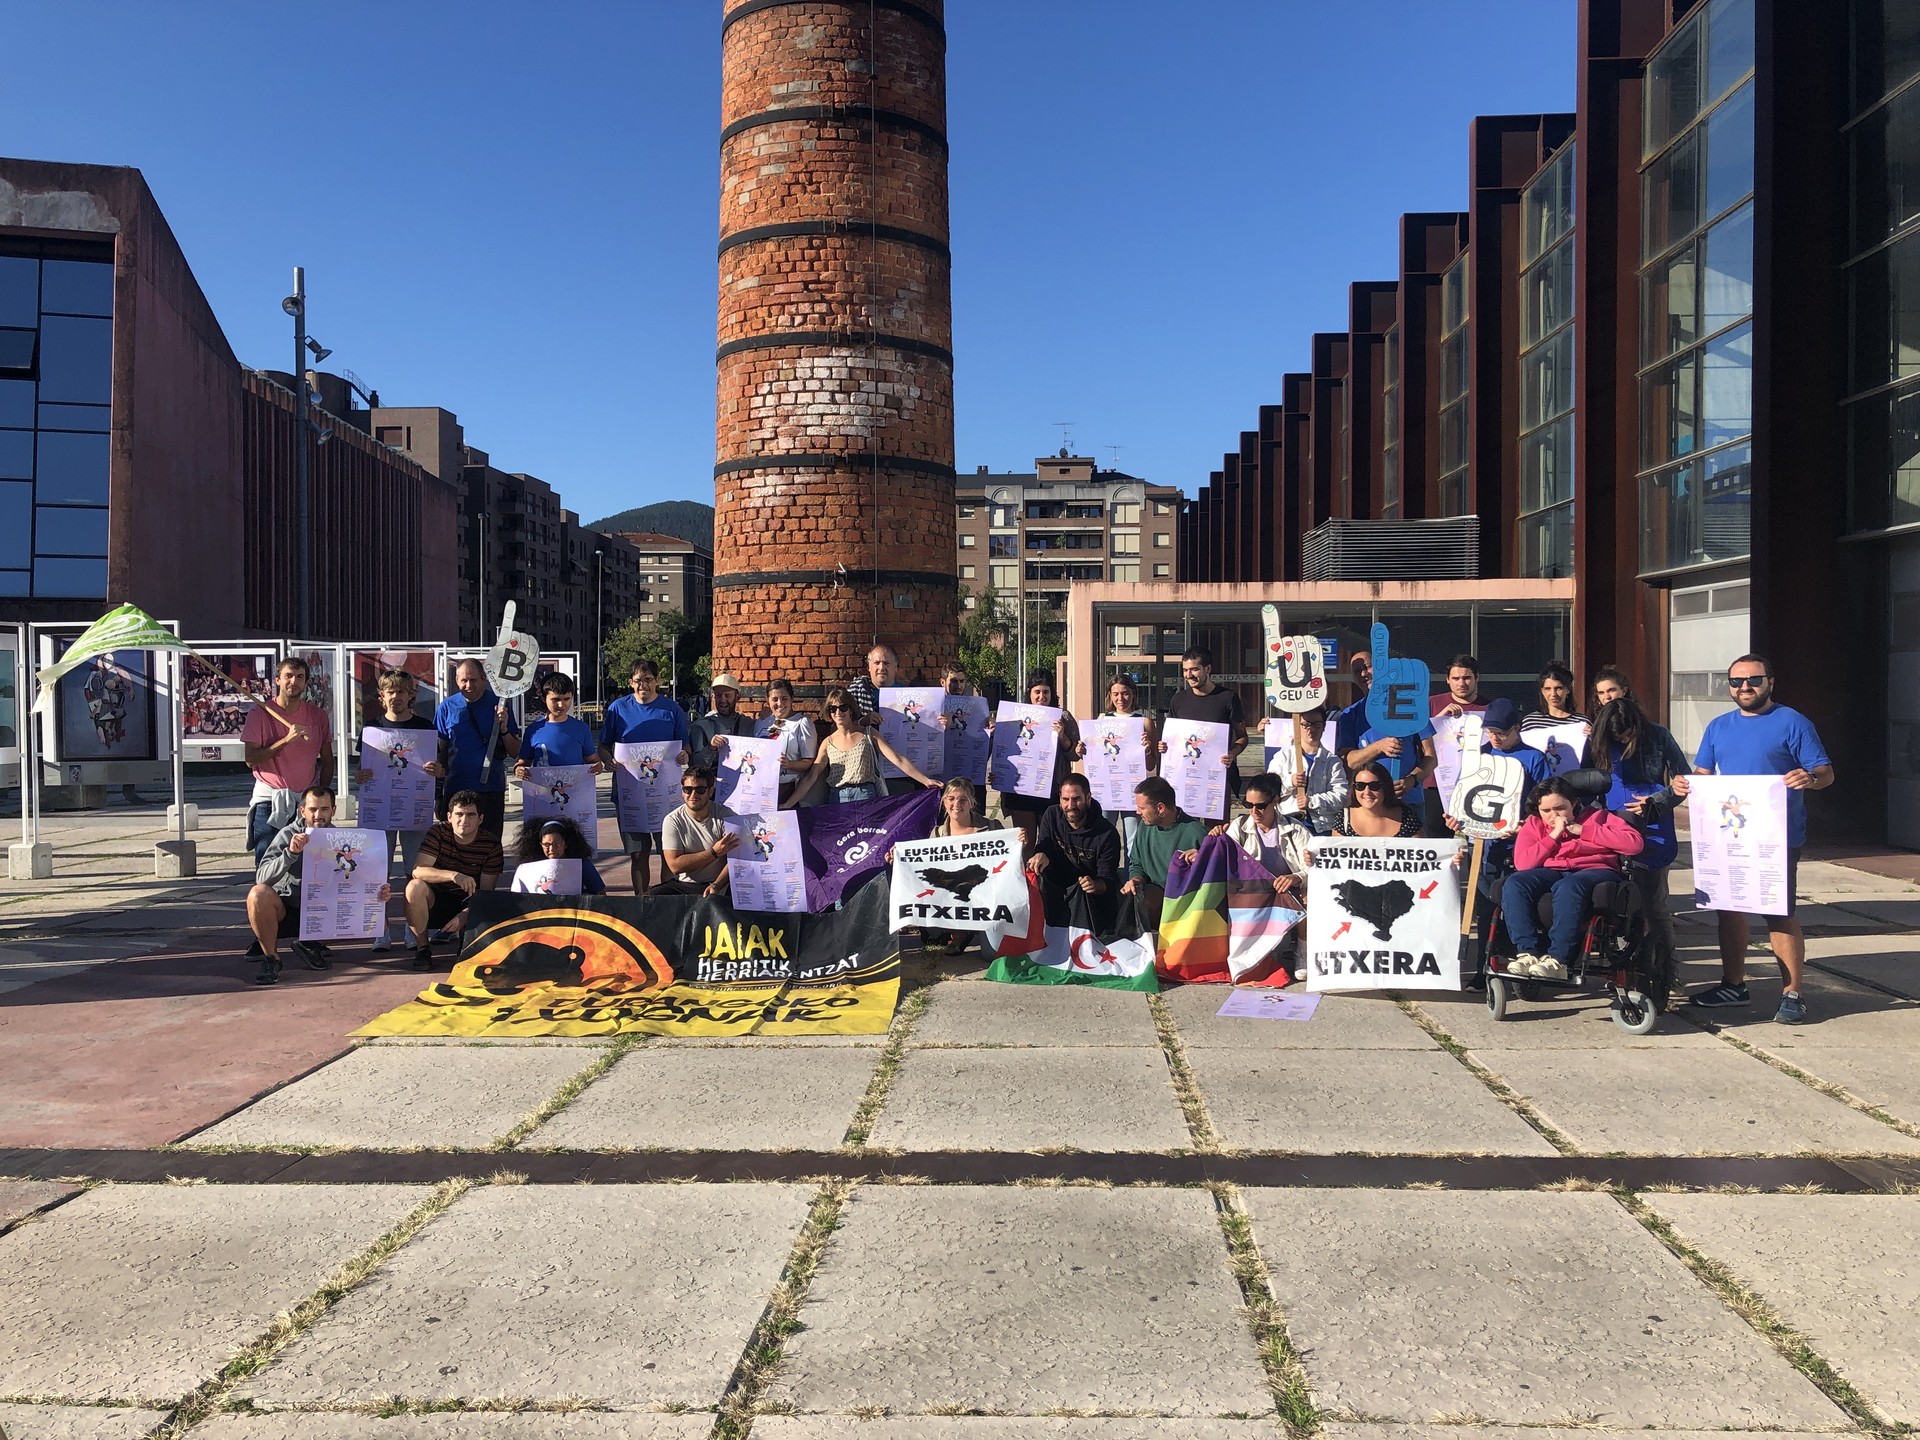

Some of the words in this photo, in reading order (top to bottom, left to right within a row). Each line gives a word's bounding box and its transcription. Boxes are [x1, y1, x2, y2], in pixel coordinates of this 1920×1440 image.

[498, 647, 527, 682] B
[1277, 651, 1313, 688] U
[1211, 673, 1258, 682] ANDAKO
[1279, 690, 1303, 701] GEU
[1306, 688, 1320, 699] BE
[1384, 683, 1418, 720] E
[1464, 784, 1505, 823] G
[836, 831, 856, 847] Gora
[904, 845, 957, 857] EUSKAL
[961, 840, 1006, 852] PRESO
[929, 848, 1010, 862] IHESLARIAK
[1320, 848, 1380, 859] EUSKAL
[1386, 849, 1438, 861] PRESO
[1315, 858, 1342, 869] ETA
[1348, 859, 1442, 873] IHESLARIAK
[899, 903, 1014, 924] ETXERA
[698, 921, 788, 960] JAIAK
[1314, 950, 1442, 976] ETXERA
